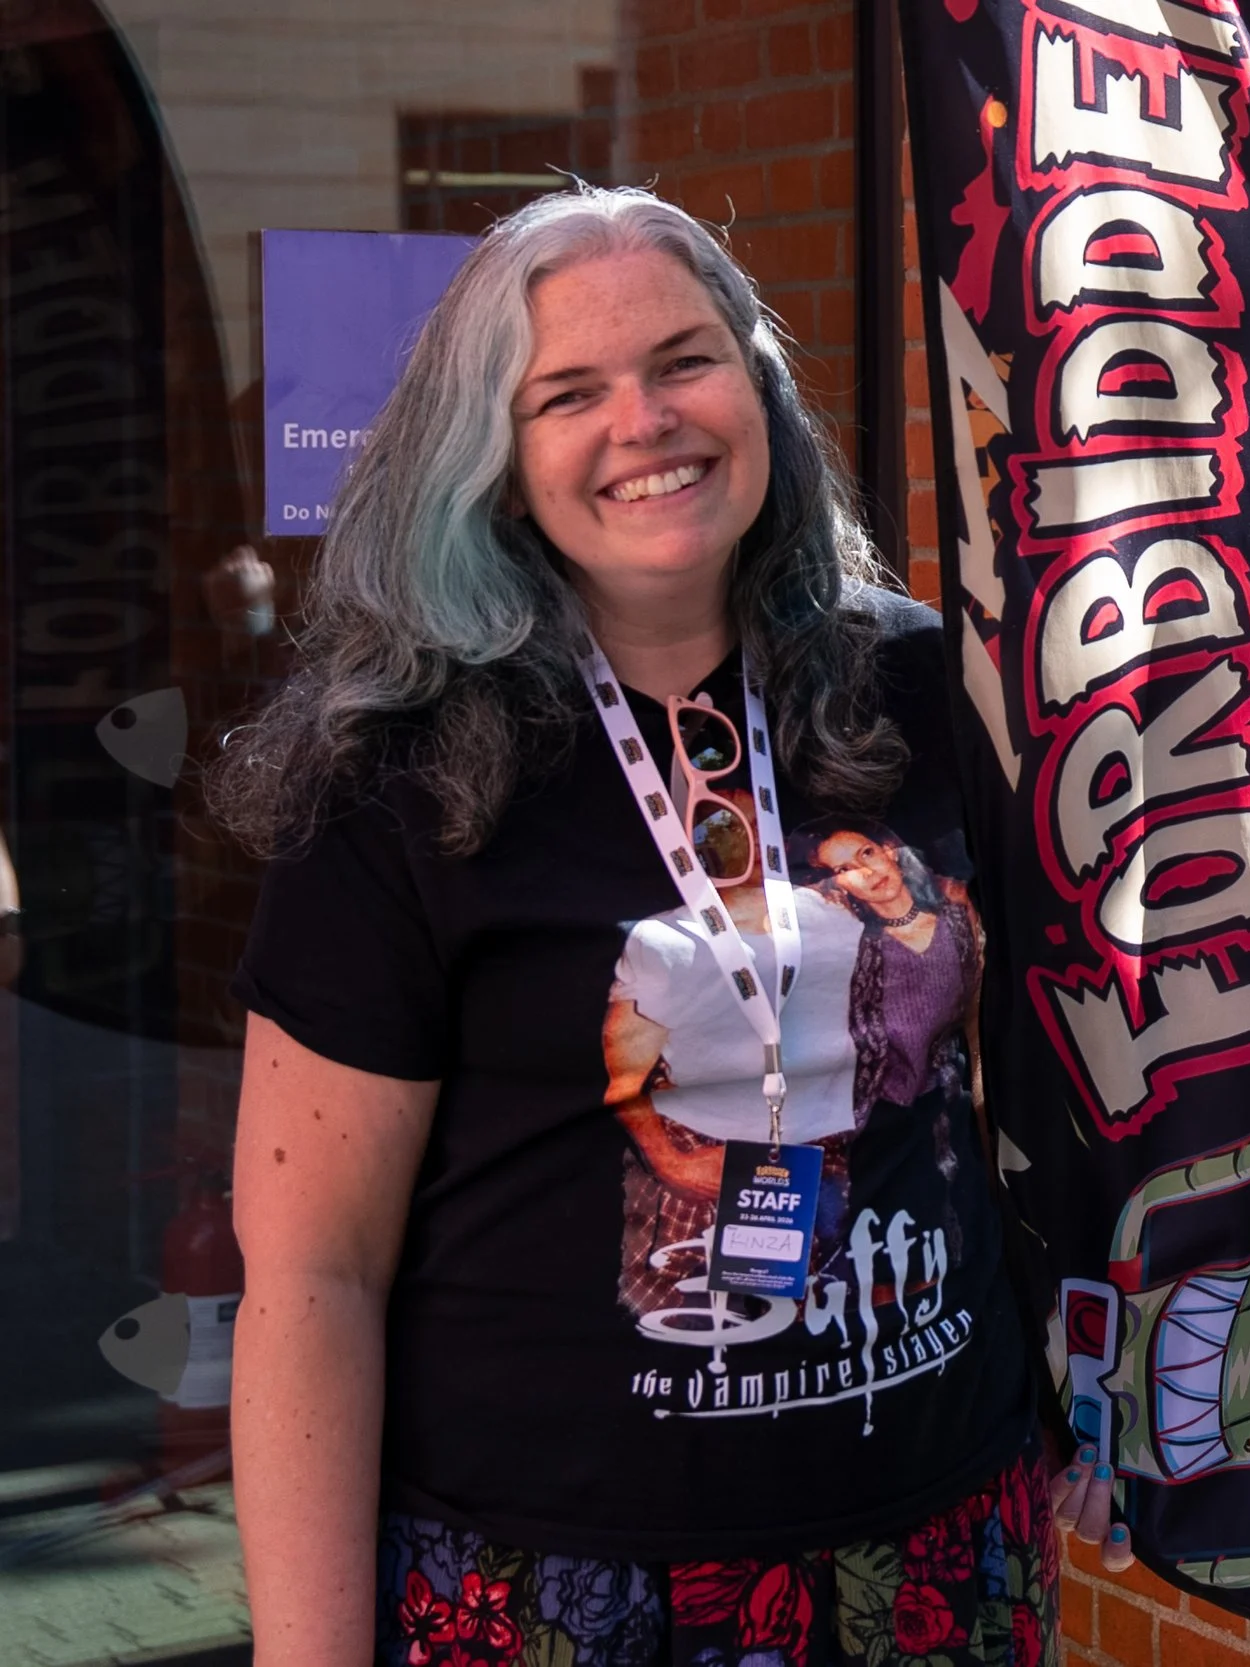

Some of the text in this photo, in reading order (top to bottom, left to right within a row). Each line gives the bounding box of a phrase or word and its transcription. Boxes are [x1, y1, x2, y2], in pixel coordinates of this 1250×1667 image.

[283, 504, 310, 520] Do
[737, 1189, 801, 1212] STAFF
[631, 1369, 673, 1398] the
[883, 1309, 974, 1377] slayer
